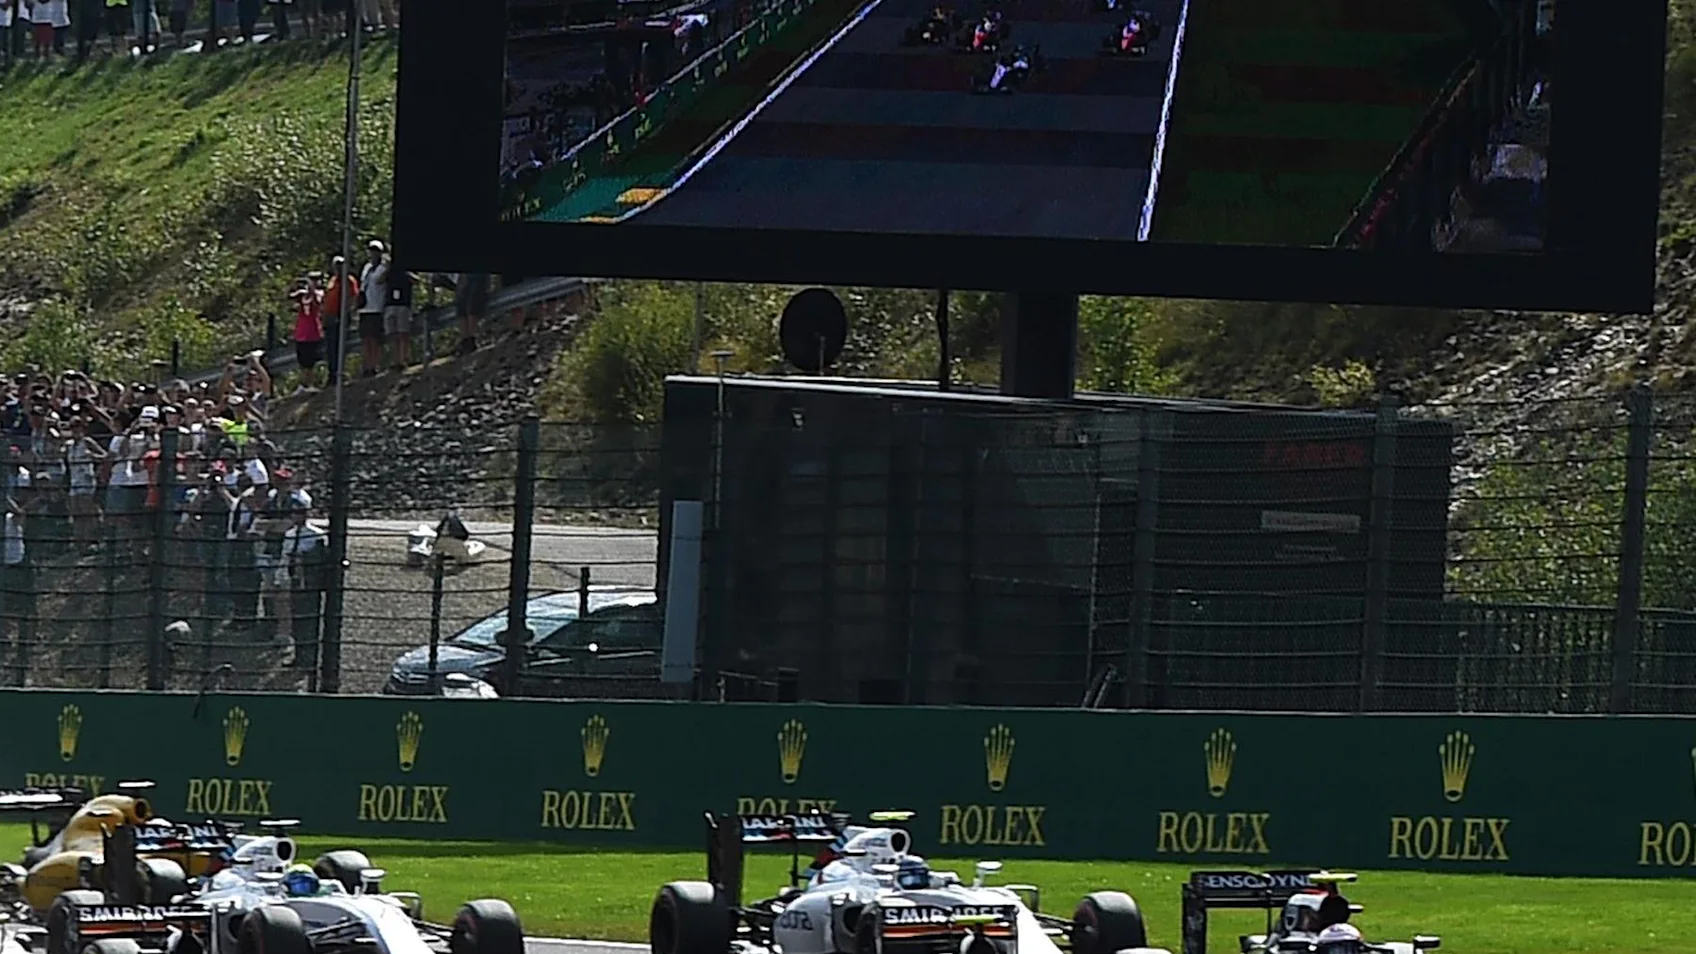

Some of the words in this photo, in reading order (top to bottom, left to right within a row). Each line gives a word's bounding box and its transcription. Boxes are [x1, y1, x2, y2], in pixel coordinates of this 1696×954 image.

[185, 778, 272, 816] ROLEX
[357, 784, 449, 823] ROLEX
[541, 790, 636, 831] ROLEX
[940, 805, 1045, 847] ROLEX
[1157, 811, 1270, 854] ROLEX
[1388, 816, 1510, 862] ROLEX
